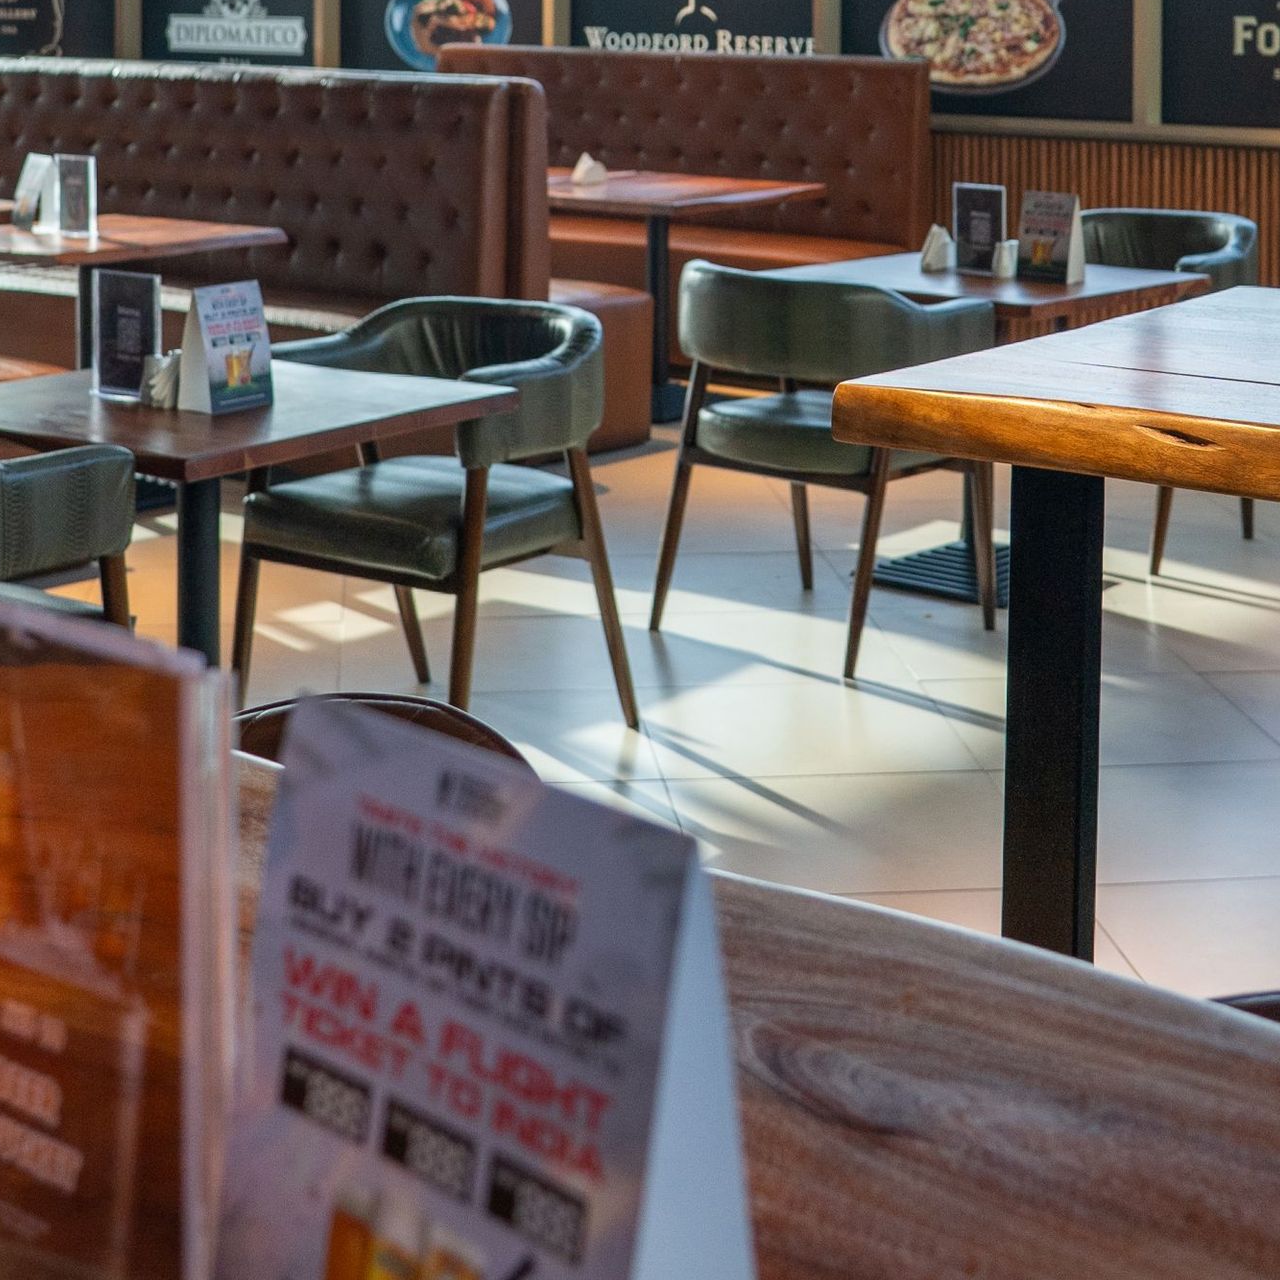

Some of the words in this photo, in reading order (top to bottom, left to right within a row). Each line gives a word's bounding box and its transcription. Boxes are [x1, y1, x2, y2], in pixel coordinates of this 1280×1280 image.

[584, 26, 709, 52] WOODFORD
[288, 874, 373, 931] BUY
[388, 916, 416, 954] 2
[422, 931, 552, 1017] PINTS
[562, 996, 625, 1042] OF
[350, 821, 420, 902] WITH
[425, 851, 516, 939] EVERY
[526, 889, 578, 968] SIP
[281, 943, 380, 1019] WIN
[391, 1000, 428, 1045] A
[440, 1020, 614, 1129] FLIGHT
[281, 989, 412, 1078] TICKET
[427, 1062, 484, 1121] TO
[492, 1102, 605, 1182] INDIA
